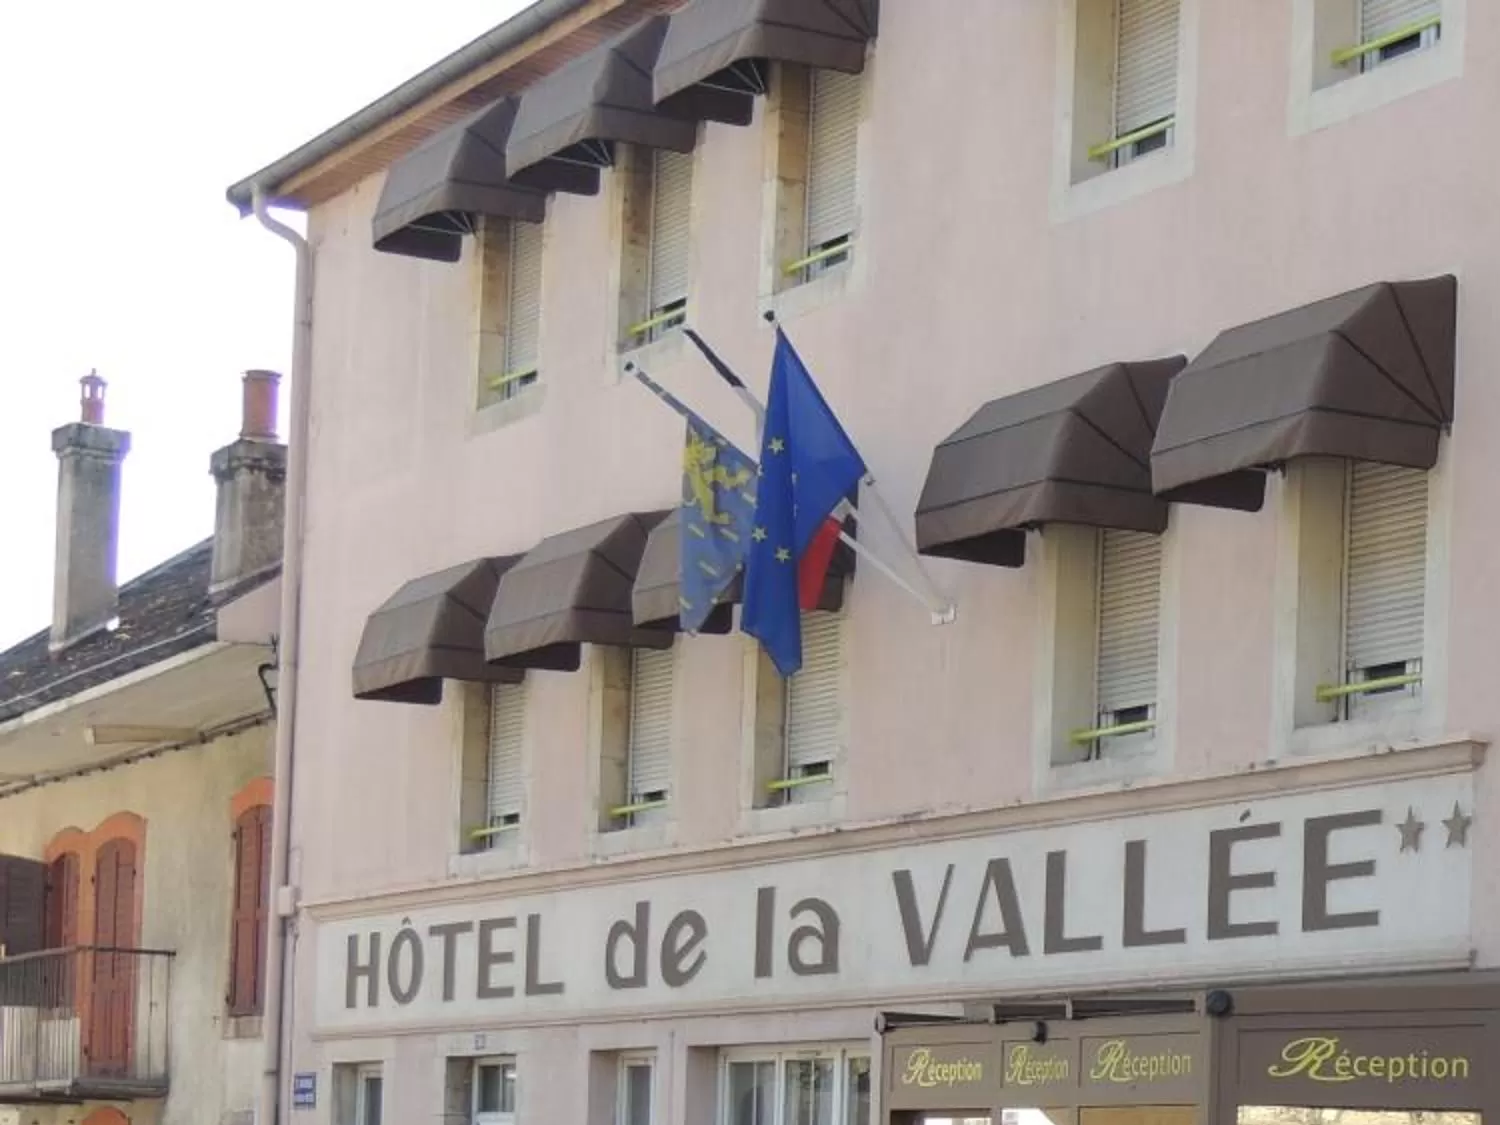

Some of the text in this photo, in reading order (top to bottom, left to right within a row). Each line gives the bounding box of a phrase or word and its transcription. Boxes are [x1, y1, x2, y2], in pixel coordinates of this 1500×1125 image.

[344, 809, 1384, 1009] HÔTEL de la VALLÉE
[902, 1046, 983, 1088] Réception
[1005, 1044, 1069, 1086] Réception
[1089, 1039, 1192, 1083] Réception
[1267, 1035, 1470, 1083] Réception
